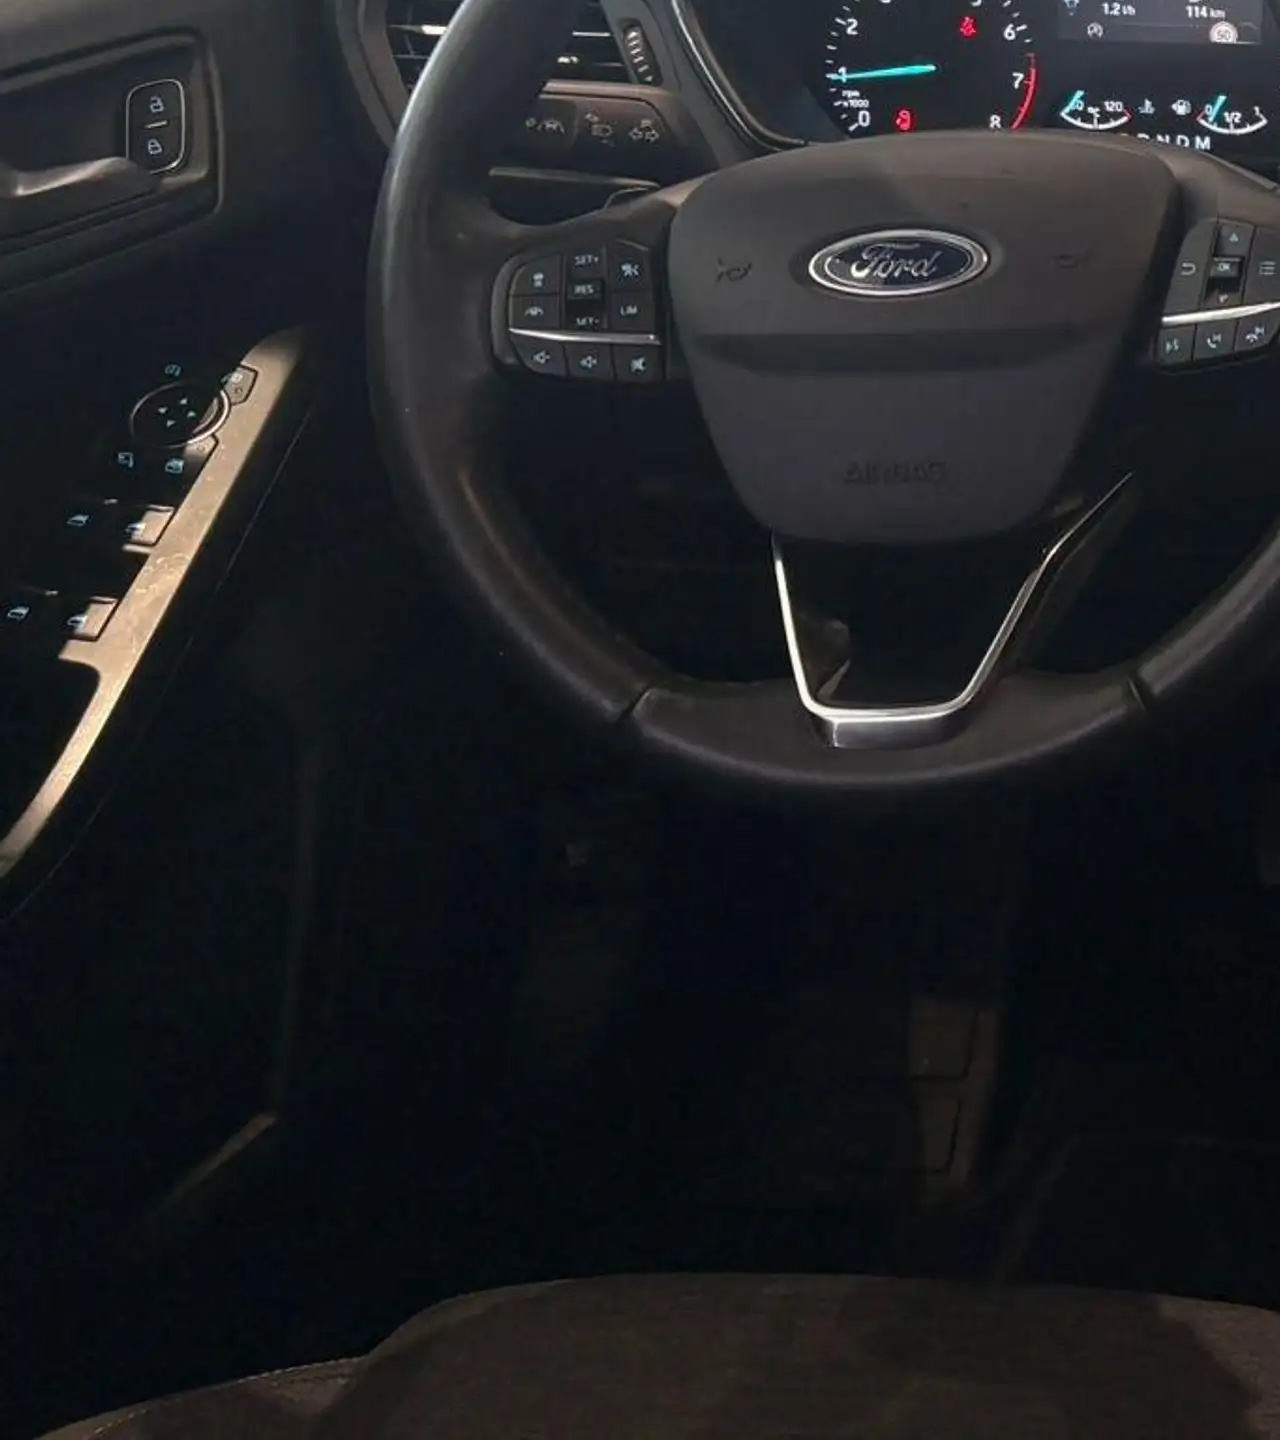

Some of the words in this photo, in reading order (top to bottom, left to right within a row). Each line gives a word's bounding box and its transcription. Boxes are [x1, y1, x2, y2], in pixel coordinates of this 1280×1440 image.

[1102, 3, 1121, 15] 1.2
[1186, 5, 1208, 18] 114
[1209, 8, 1227, 19] km
[846, 18, 859, 35] 2
[1003, 24, 1016, 40] 6
[1012, 72, 1025, 89] 7
[1104, 101, 1123, 112] 120
[1204, 104, 1213, 116] 0
[858, 110, 871, 127] 0
[1195, 135, 1211, 150] M
[851, 242, 943, 279] Ford
